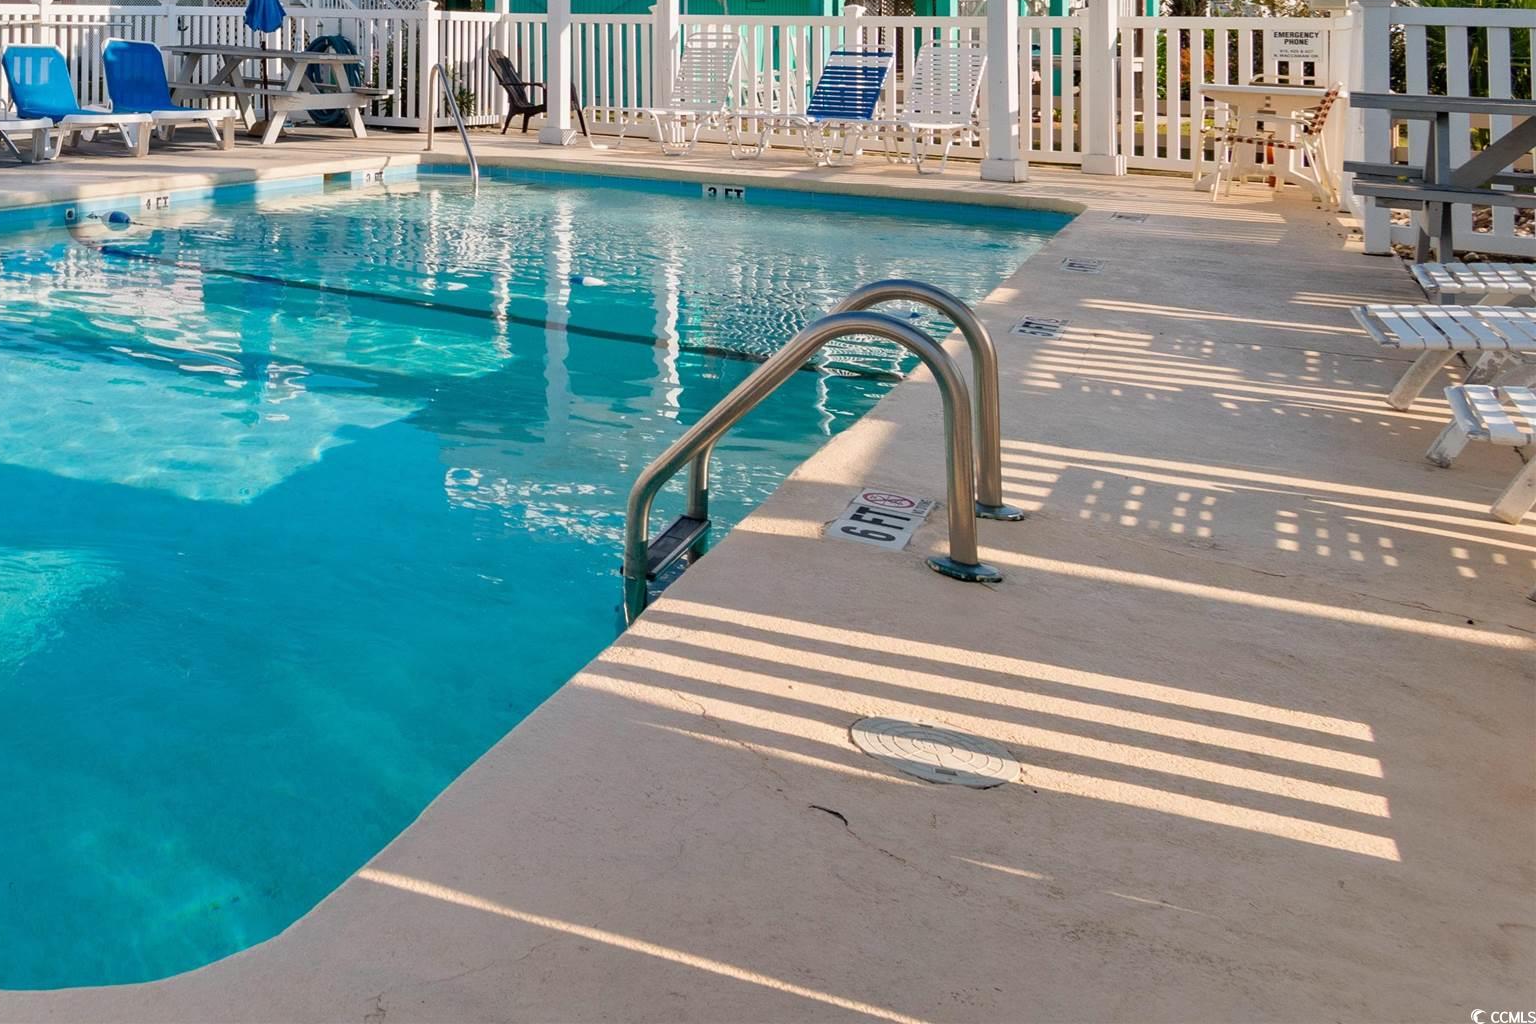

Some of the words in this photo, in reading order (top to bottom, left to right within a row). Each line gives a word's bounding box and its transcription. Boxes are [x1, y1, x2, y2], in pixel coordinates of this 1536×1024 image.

[724, 188, 744, 200] FT
[850, 506, 911, 531] FT
[841, 526, 896, 542] 6
